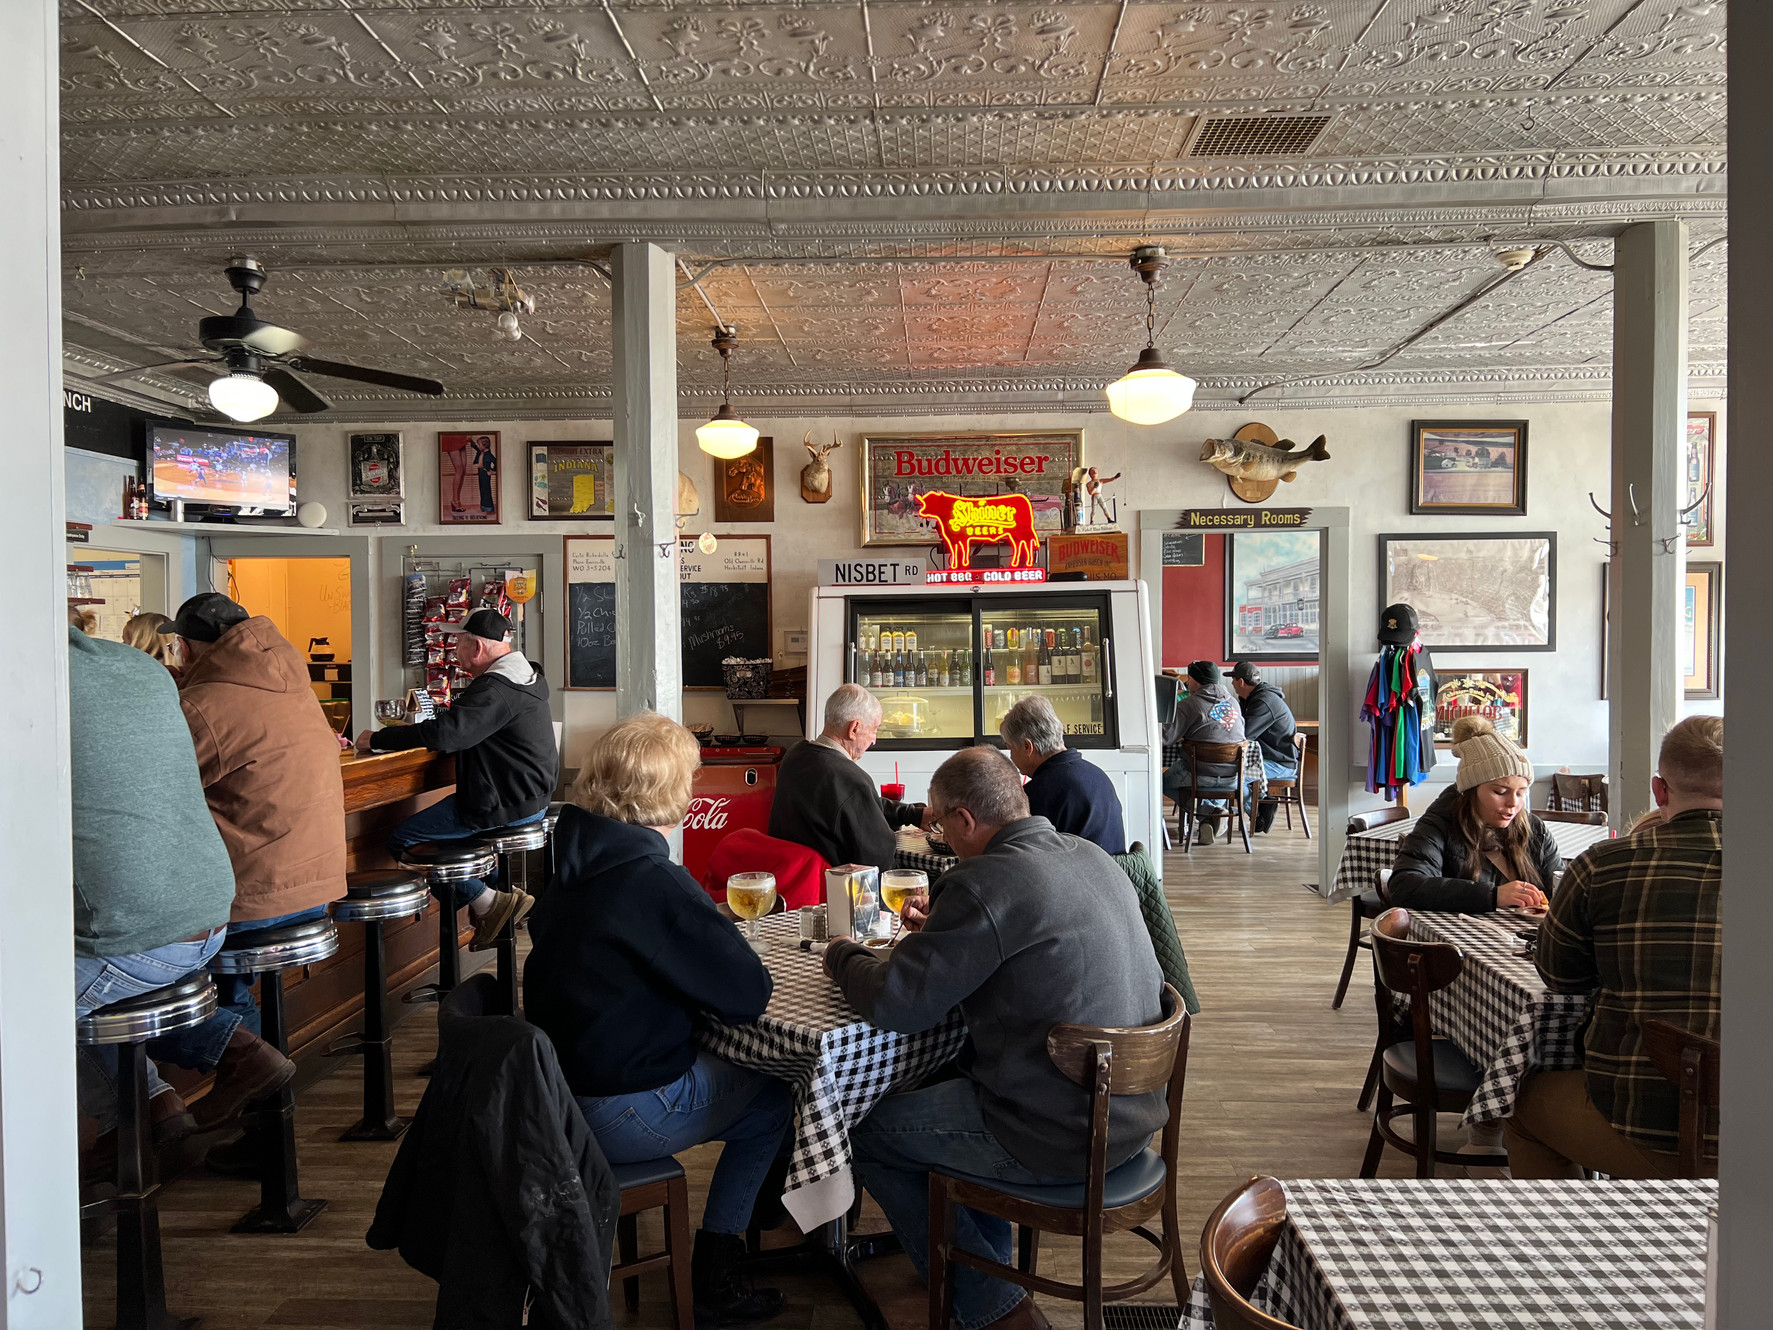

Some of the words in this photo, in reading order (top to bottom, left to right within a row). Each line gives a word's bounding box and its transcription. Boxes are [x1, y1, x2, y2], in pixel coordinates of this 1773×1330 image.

[554, 461, 599, 473] INDIANA
[894, 449, 1050, 477] Budweiser
[948, 500, 1017, 531] Shiner
[1190, 511, 1255, 528] Necessary
[1261, 510, 1301, 525] Rooms
[966, 526, 1004, 535] BEERS
[1058, 540, 1120, 564] BUDWEISER
[835, 563, 900, 583] NISBET
[904, 565, 919, 576] RD
[926, 573, 947, 583] HOT
[950, 573, 972, 582] BBQ
[983, 572, 1011, 582] COLD
[1013, 570, 1043, 581] BEER
[687, 624, 735, 651] Mushrooms
[1073, 724, 1102, 735] SERVICE
[683, 798, 731, 830] Cola
